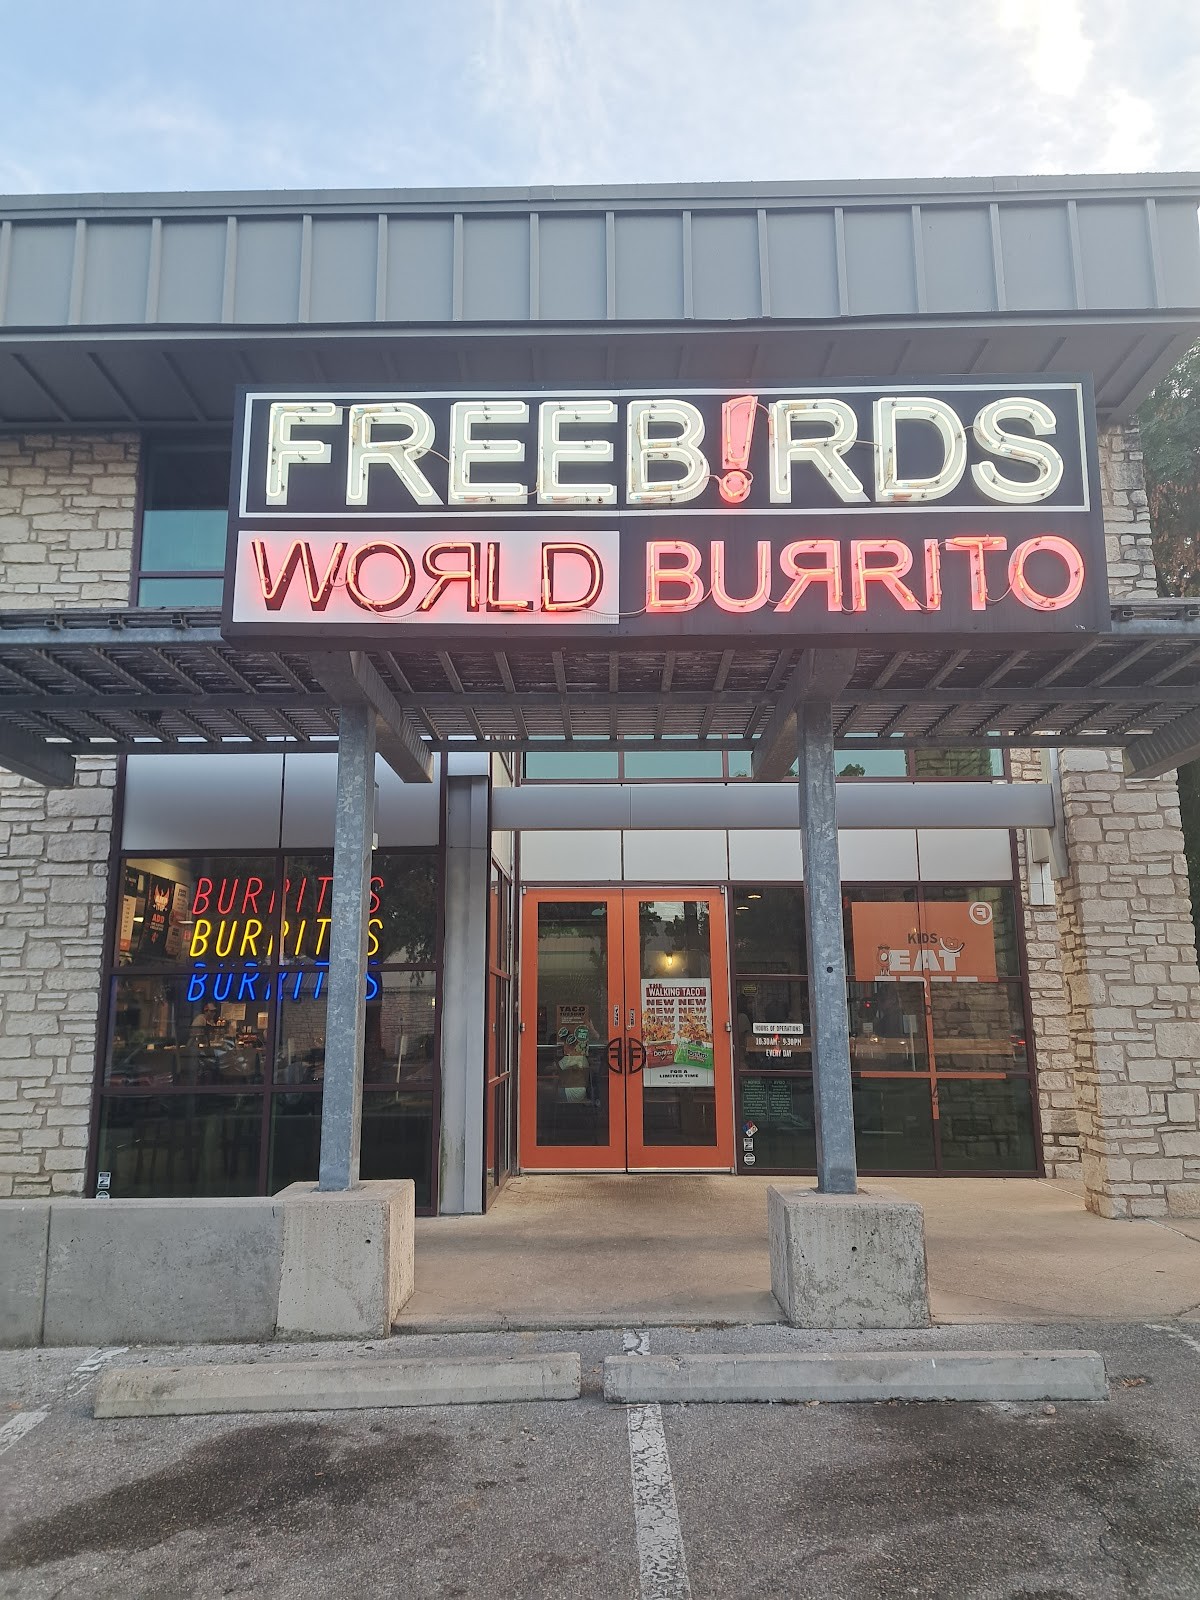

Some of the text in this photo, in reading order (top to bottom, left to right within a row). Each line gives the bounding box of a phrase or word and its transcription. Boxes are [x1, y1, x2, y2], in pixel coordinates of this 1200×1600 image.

[266, 396, 1064, 505] FREEB!RDS
[645, 535, 1085, 612] BURRITO
[191, 876, 385, 915] BURITS
[189, 918, 384, 958] BURITS
[907, 932, 938, 944] KIDS
[889, 949, 960, 972] EAT
[648, 987, 680, 997] WALKING
[765, 1049, 792, 1057] EVERY DAY
